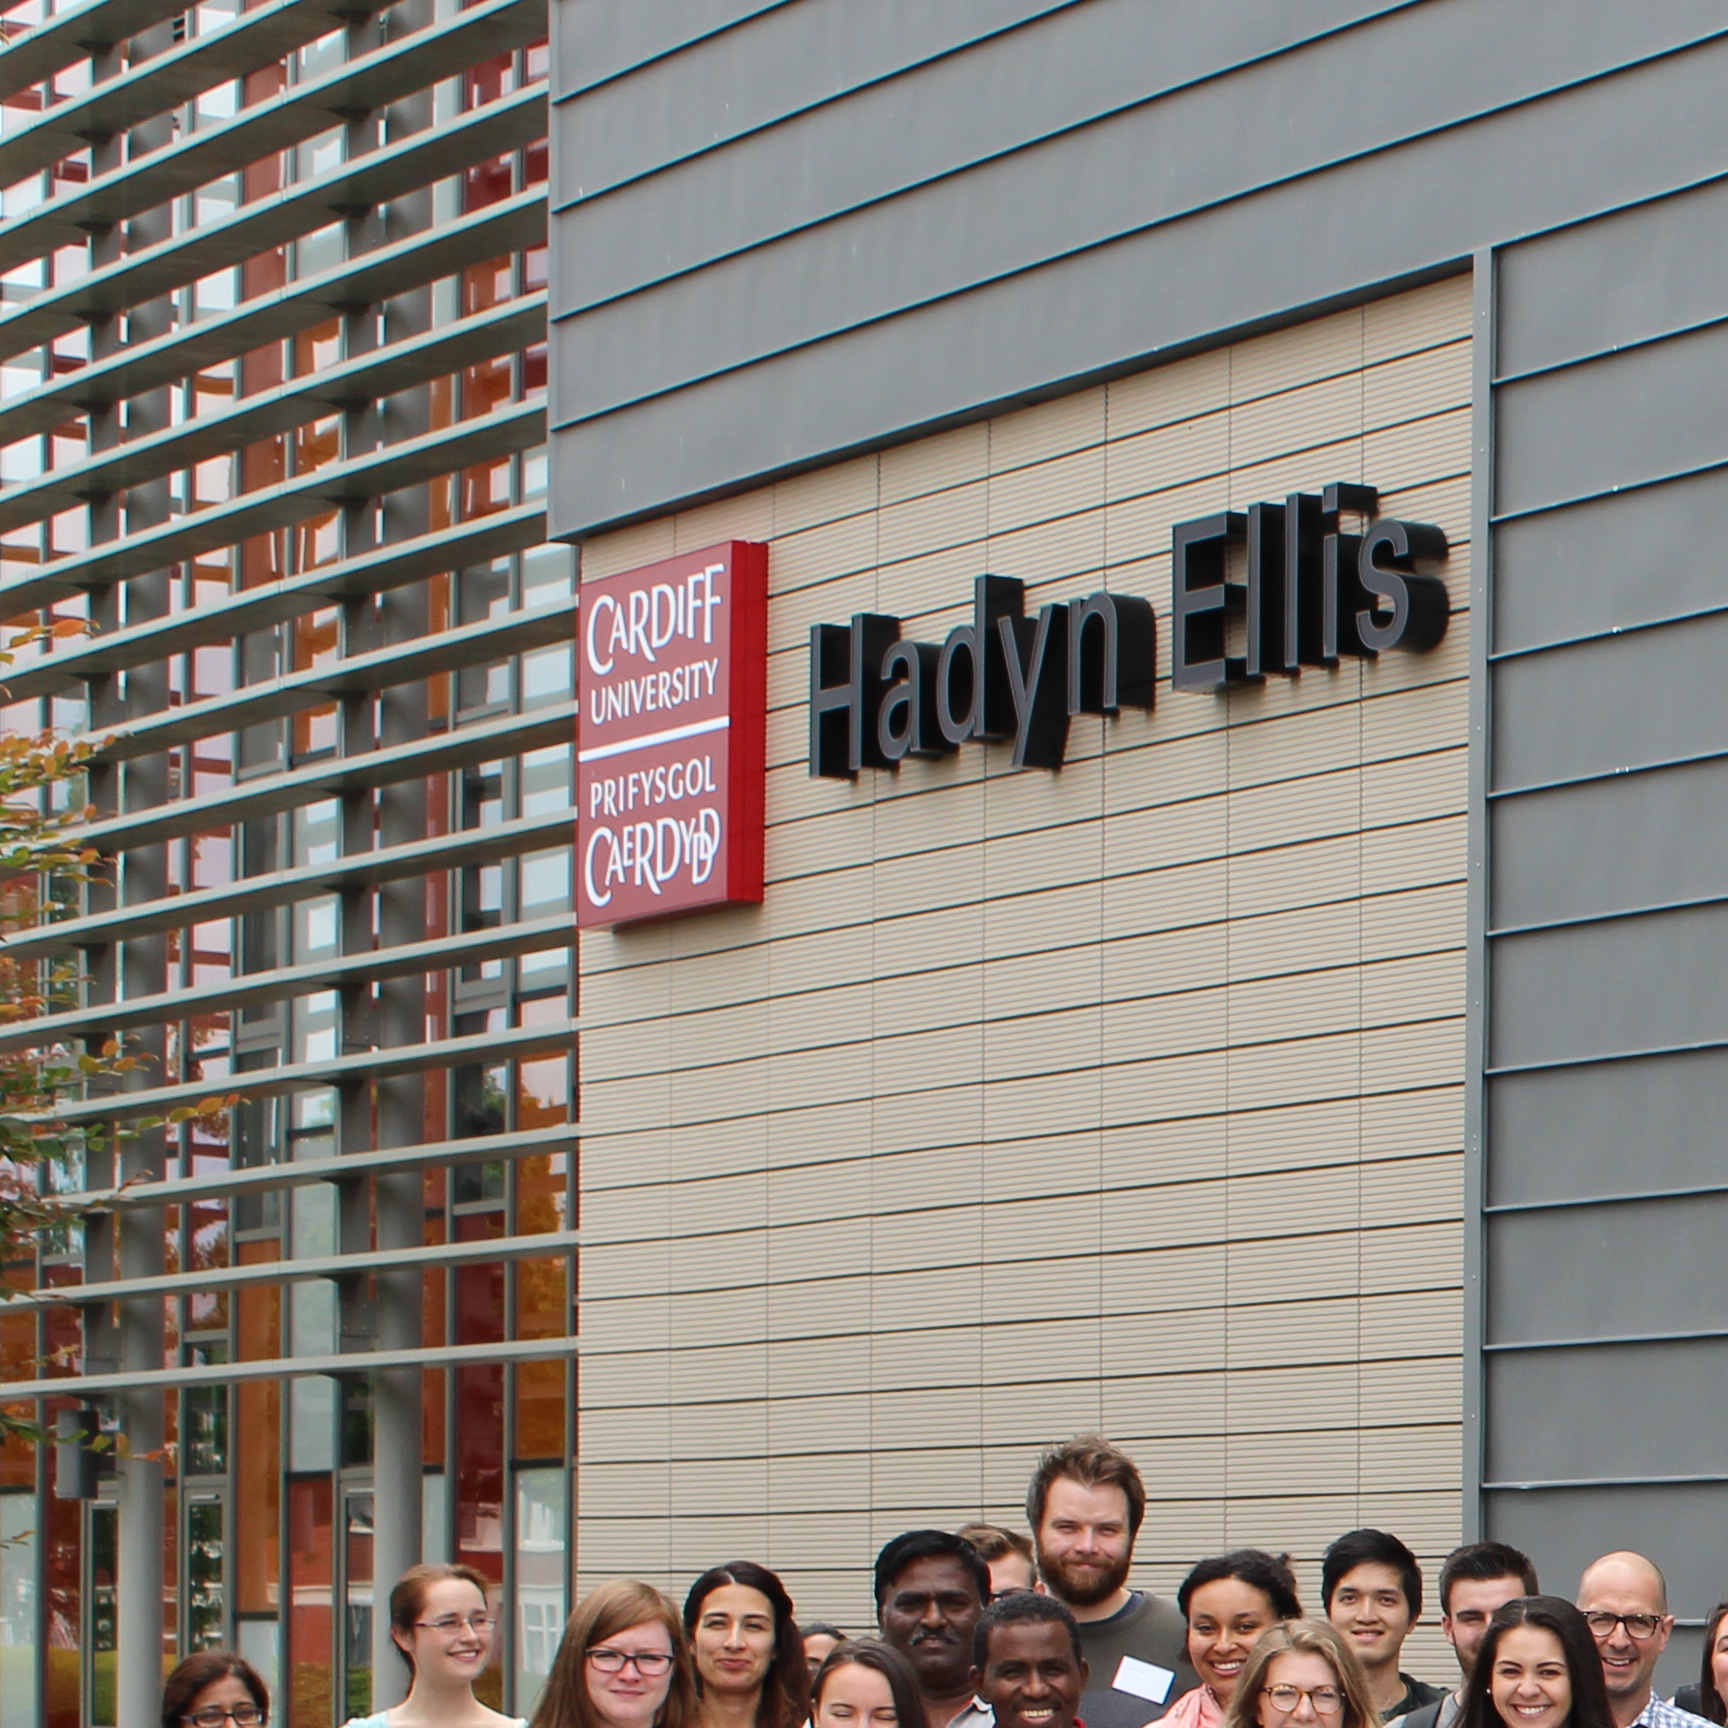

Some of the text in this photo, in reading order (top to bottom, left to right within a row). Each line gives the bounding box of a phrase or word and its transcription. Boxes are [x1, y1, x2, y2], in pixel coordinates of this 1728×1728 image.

[587, 562, 726, 676] CARDIFF
[809, 481, 1450, 780] Hadyn Ellis
[591, 656, 720, 725] UNIVERSITY
[590, 754, 717, 820] PRIFYSGOL
